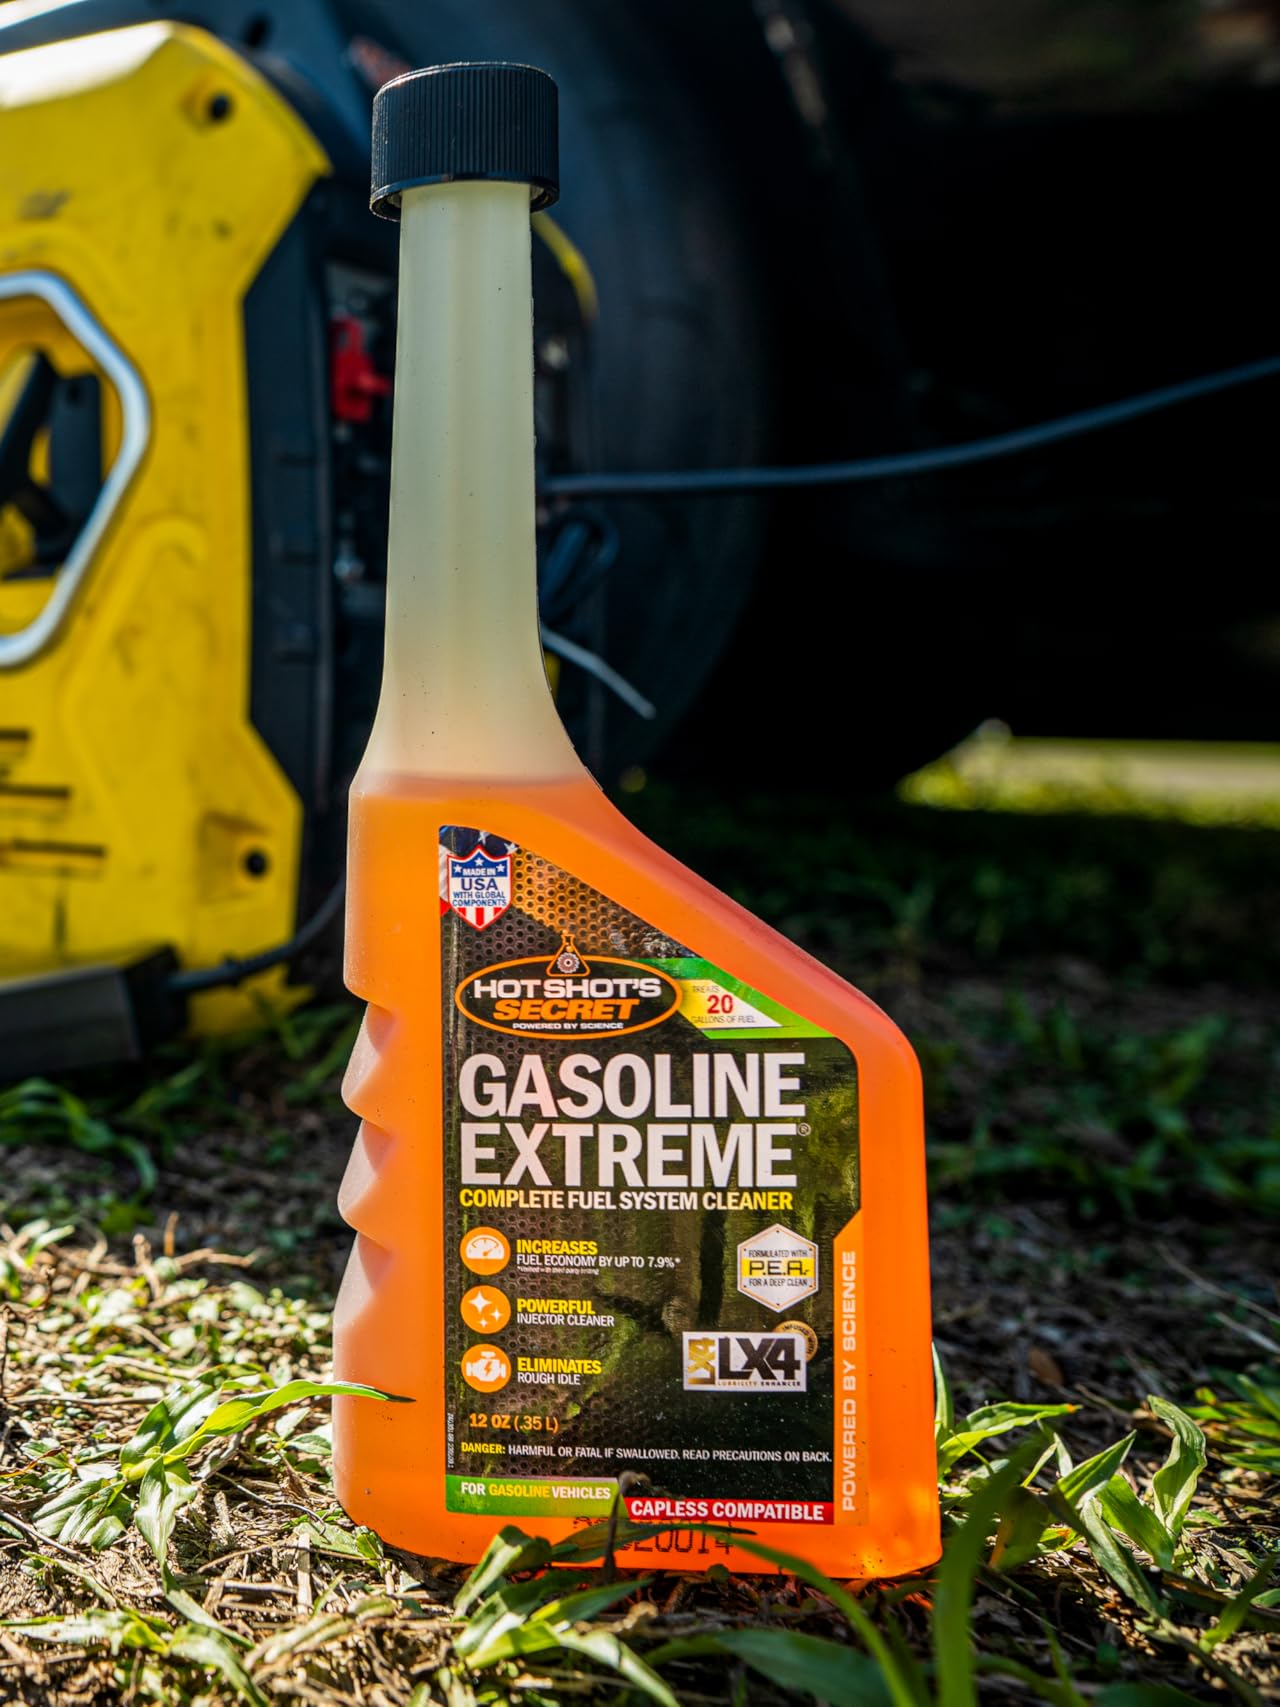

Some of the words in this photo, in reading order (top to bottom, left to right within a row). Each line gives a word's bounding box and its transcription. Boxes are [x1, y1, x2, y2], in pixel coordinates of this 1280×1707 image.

[462, 868, 486, 876] MADE
[487, 868, 496, 876] IN
[461, 878, 498, 890] USA
[493, 999, 640, 1020] SECRET
[707, 994, 734, 1014] 20
[580, 1022, 624, 1030] SCIENCE
[691, 1016, 724, 1024] GALLONS
[739, 1015, 756, 1023] FUEL
[458, 1052, 807, 1119] GASOLINE
[459, 1189, 565, 1209] COMPLETE
[567, 1190, 616, 1210] FUEL
[619, 1190, 698, 1211] SYSTEM
[702, 1191, 794, 1211] CLEANER
[516, 1239, 598, 1255] INCREASES
[516, 1255, 542, 1266] FUEL
[544, 1255, 597, 1267] ECONOMY
[598, 1256, 613, 1267] BY
[614, 1256, 630, 1268] UP
[631, 1256, 644, 1268] TO
[516, 1298, 596, 1314] POWERFUL
[842, 1251, 856, 1351] SCIENCE
[516, 1314, 565, 1325] INJECTOR
[567, 1315, 615, 1326] CLEANER
[517, 1357, 602, 1374] ELIMINATES
[718, 1338, 801, 1380] LX4
[517, 1372, 555, 1384] ROUGH
[557, 1374, 581, 1385] IDLE
[842, 1360, 856, 1391] BY
[469, 1415, 488, 1428] 12
[491, 1415, 511, 1429] OZ
[514, 1416, 543, 1432] (.35
[545, 1417, 559, 1434] L)
[461, 1442, 506, 1454] DANGER:
[508, 1444, 555, 1456] HARMFUL
[558, 1446, 572, 1457] OR
[575, 1446, 603, 1458] FATAL
[604, 1448, 614, 1458] IF
[616, 1448, 681, 1460] SWALLOWED.
[682, 1449, 710, 1460] READ
[712, 1450, 782, 1462] PRECAUTIONS
[783, 1451, 800, 1462] ON
[802, 1451, 832, 1463] BACK.
[842, 1399, 856, 1512] POWERED
[461, 1482, 485, 1495] FOR
[489, 1483, 550, 1498] GASOLINE
[551, 1485, 611, 1499] VEHICLES
[631, 1500, 708, 1517] CAPLESS
[712, 1501, 824, 1521] COMPATIBLE
